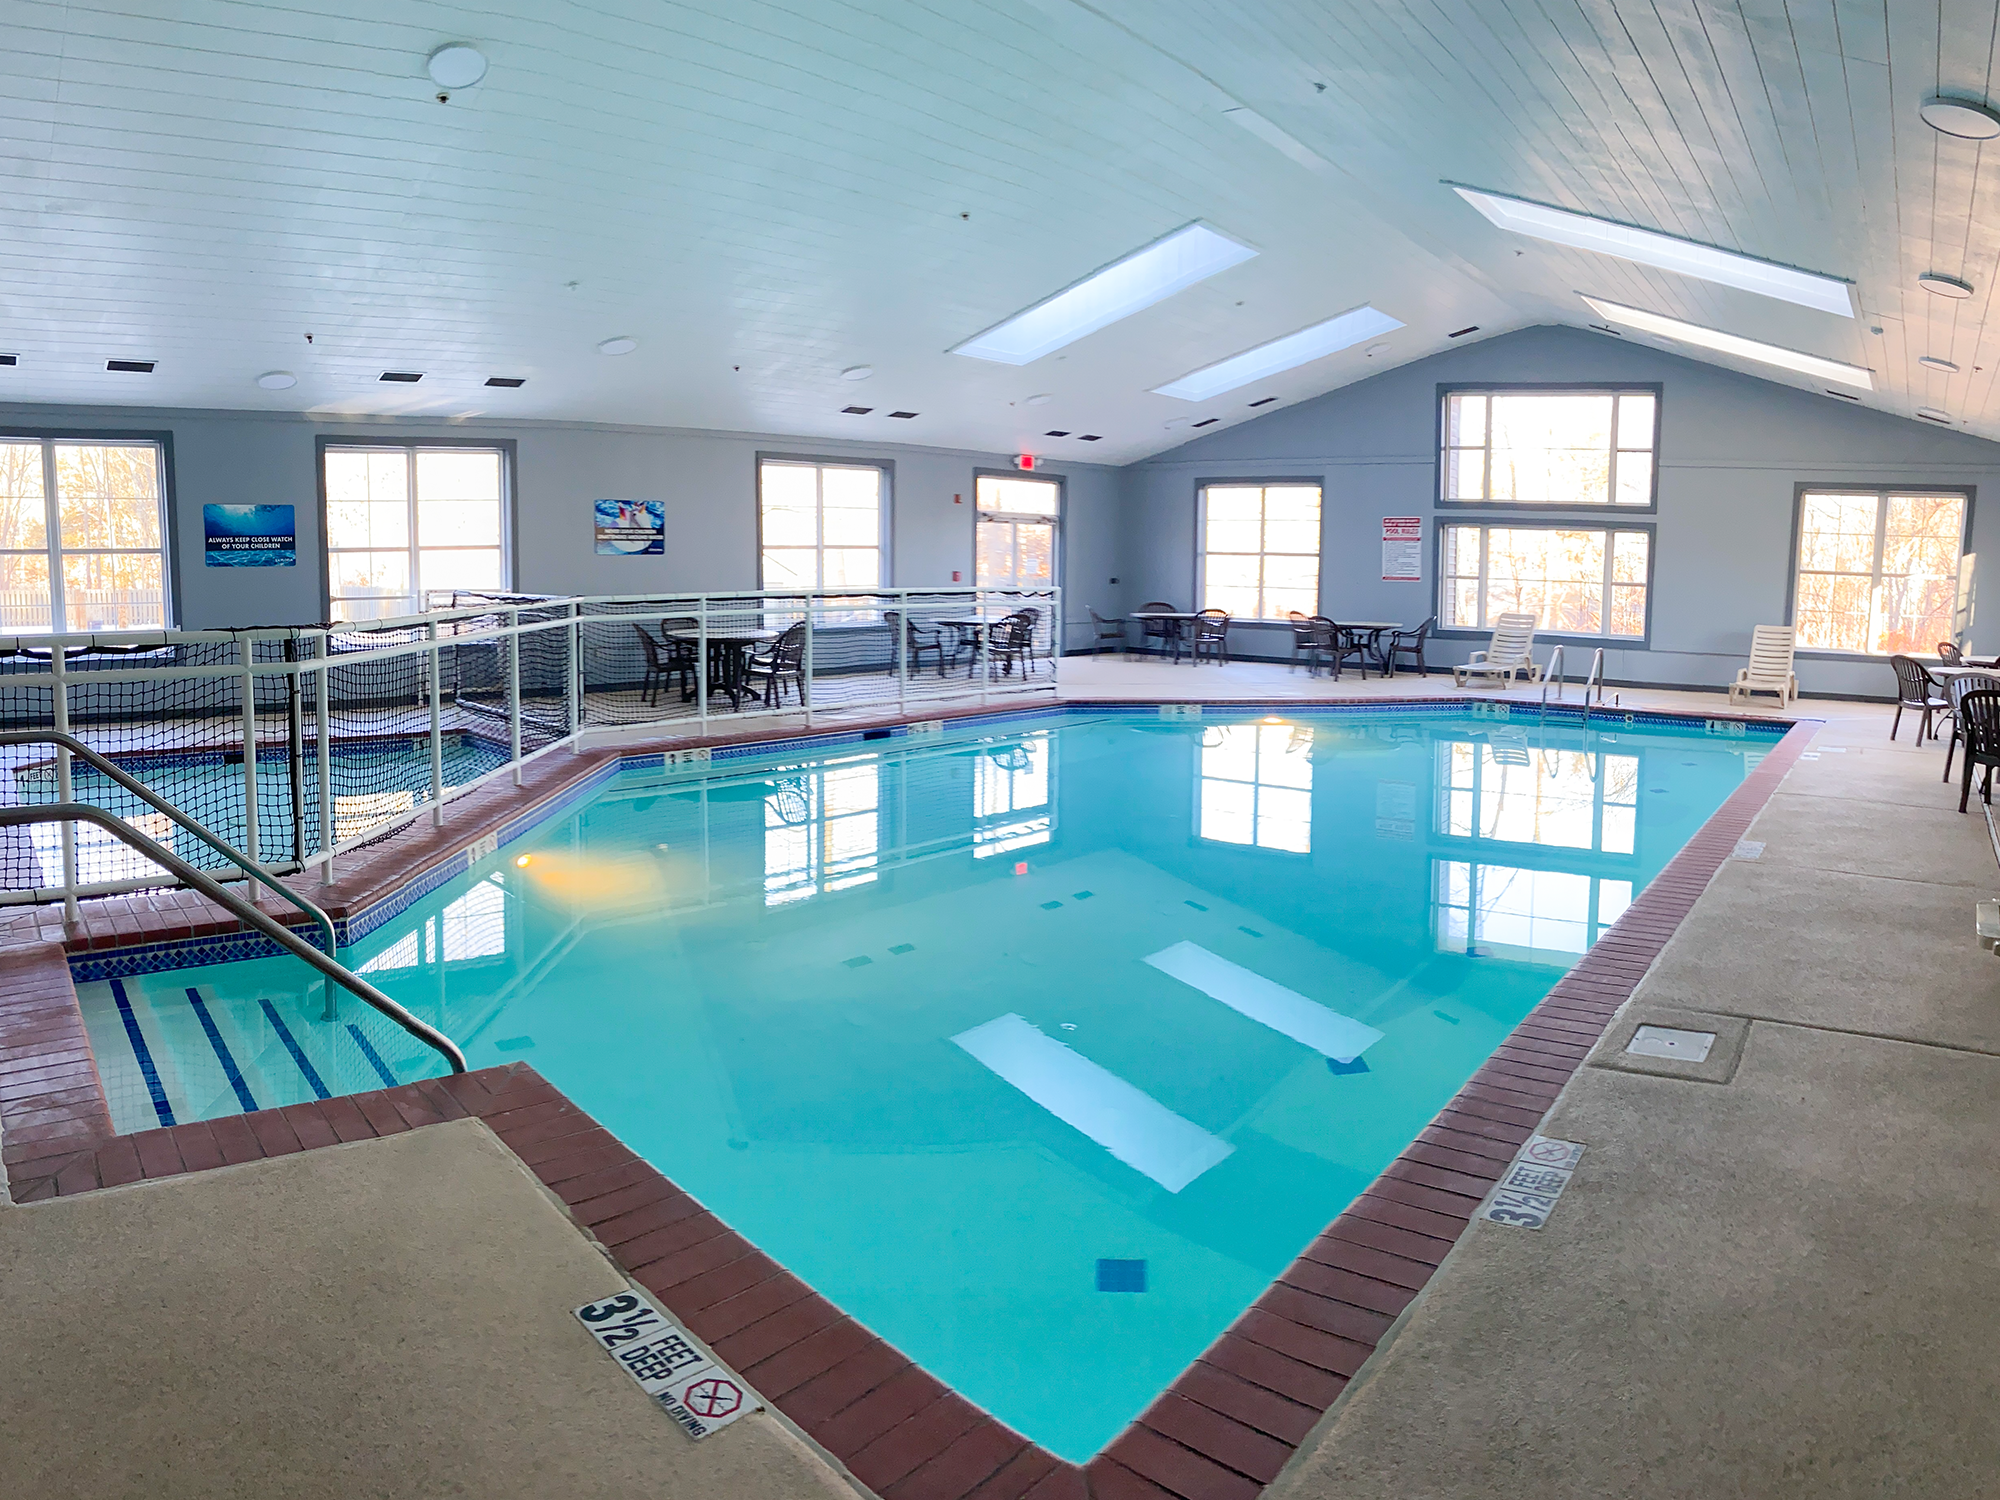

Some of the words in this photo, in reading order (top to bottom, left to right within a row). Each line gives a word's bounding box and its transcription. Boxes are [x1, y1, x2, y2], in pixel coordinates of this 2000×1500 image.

[1508, 1166, 1542, 1189] FEET
[1534, 1171, 1567, 1194] DEEP
[619, 1345, 674, 1381] DEEP
[650, 1334, 704, 1370] FEET
[657, 1391, 675, 1408] NO
[671, 1404, 707, 1436] DIVING
